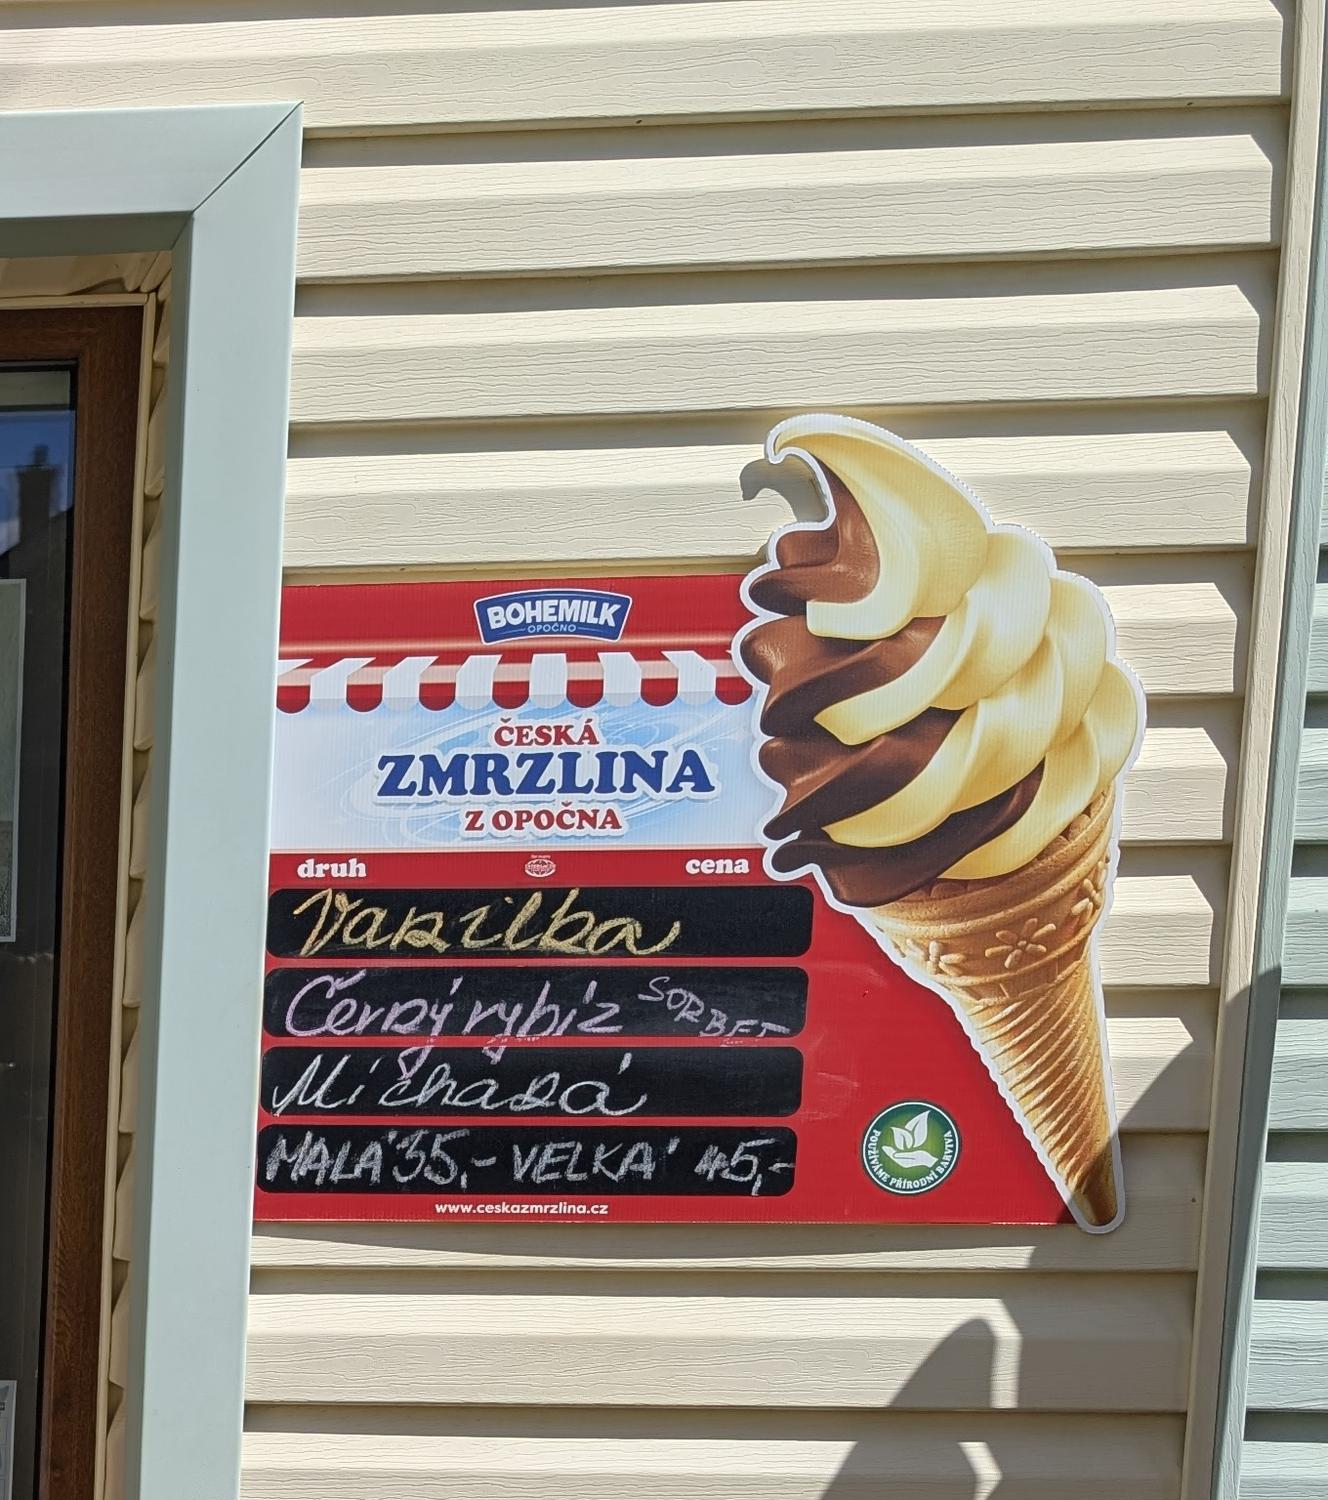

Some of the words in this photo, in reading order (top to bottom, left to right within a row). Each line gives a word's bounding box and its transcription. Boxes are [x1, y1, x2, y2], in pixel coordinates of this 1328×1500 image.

[487, 600, 621, 630] BOHEMILK
[527, 622, 577, 634] OPOČNO
[494, 716, 599, 748] ČESKÁ
[377, 750, 714, 798] ZMRZLINA
[464, 810, 485, 832] Z
[493, 802, 621, 832] OPOČNA
[297, 858, 366, 879] druh
[685, 855, 749, 875] cena
[293, 887, 680, 957] Vanilka
[286, 969, 462, 1080] Černý
[462, 981, 624, 1066] rybíz
[638, 976, 792, 1041] SORBET
[867, 1129, 891, 1183] POUŽÍVÁME
[935, 1130, 955, 1174] BARVIVA
[889, 1170, 939, 1190] PŘÍRODNÍ
[434, 1201, 609, 1217] www.ceskazmrzlina.cz
